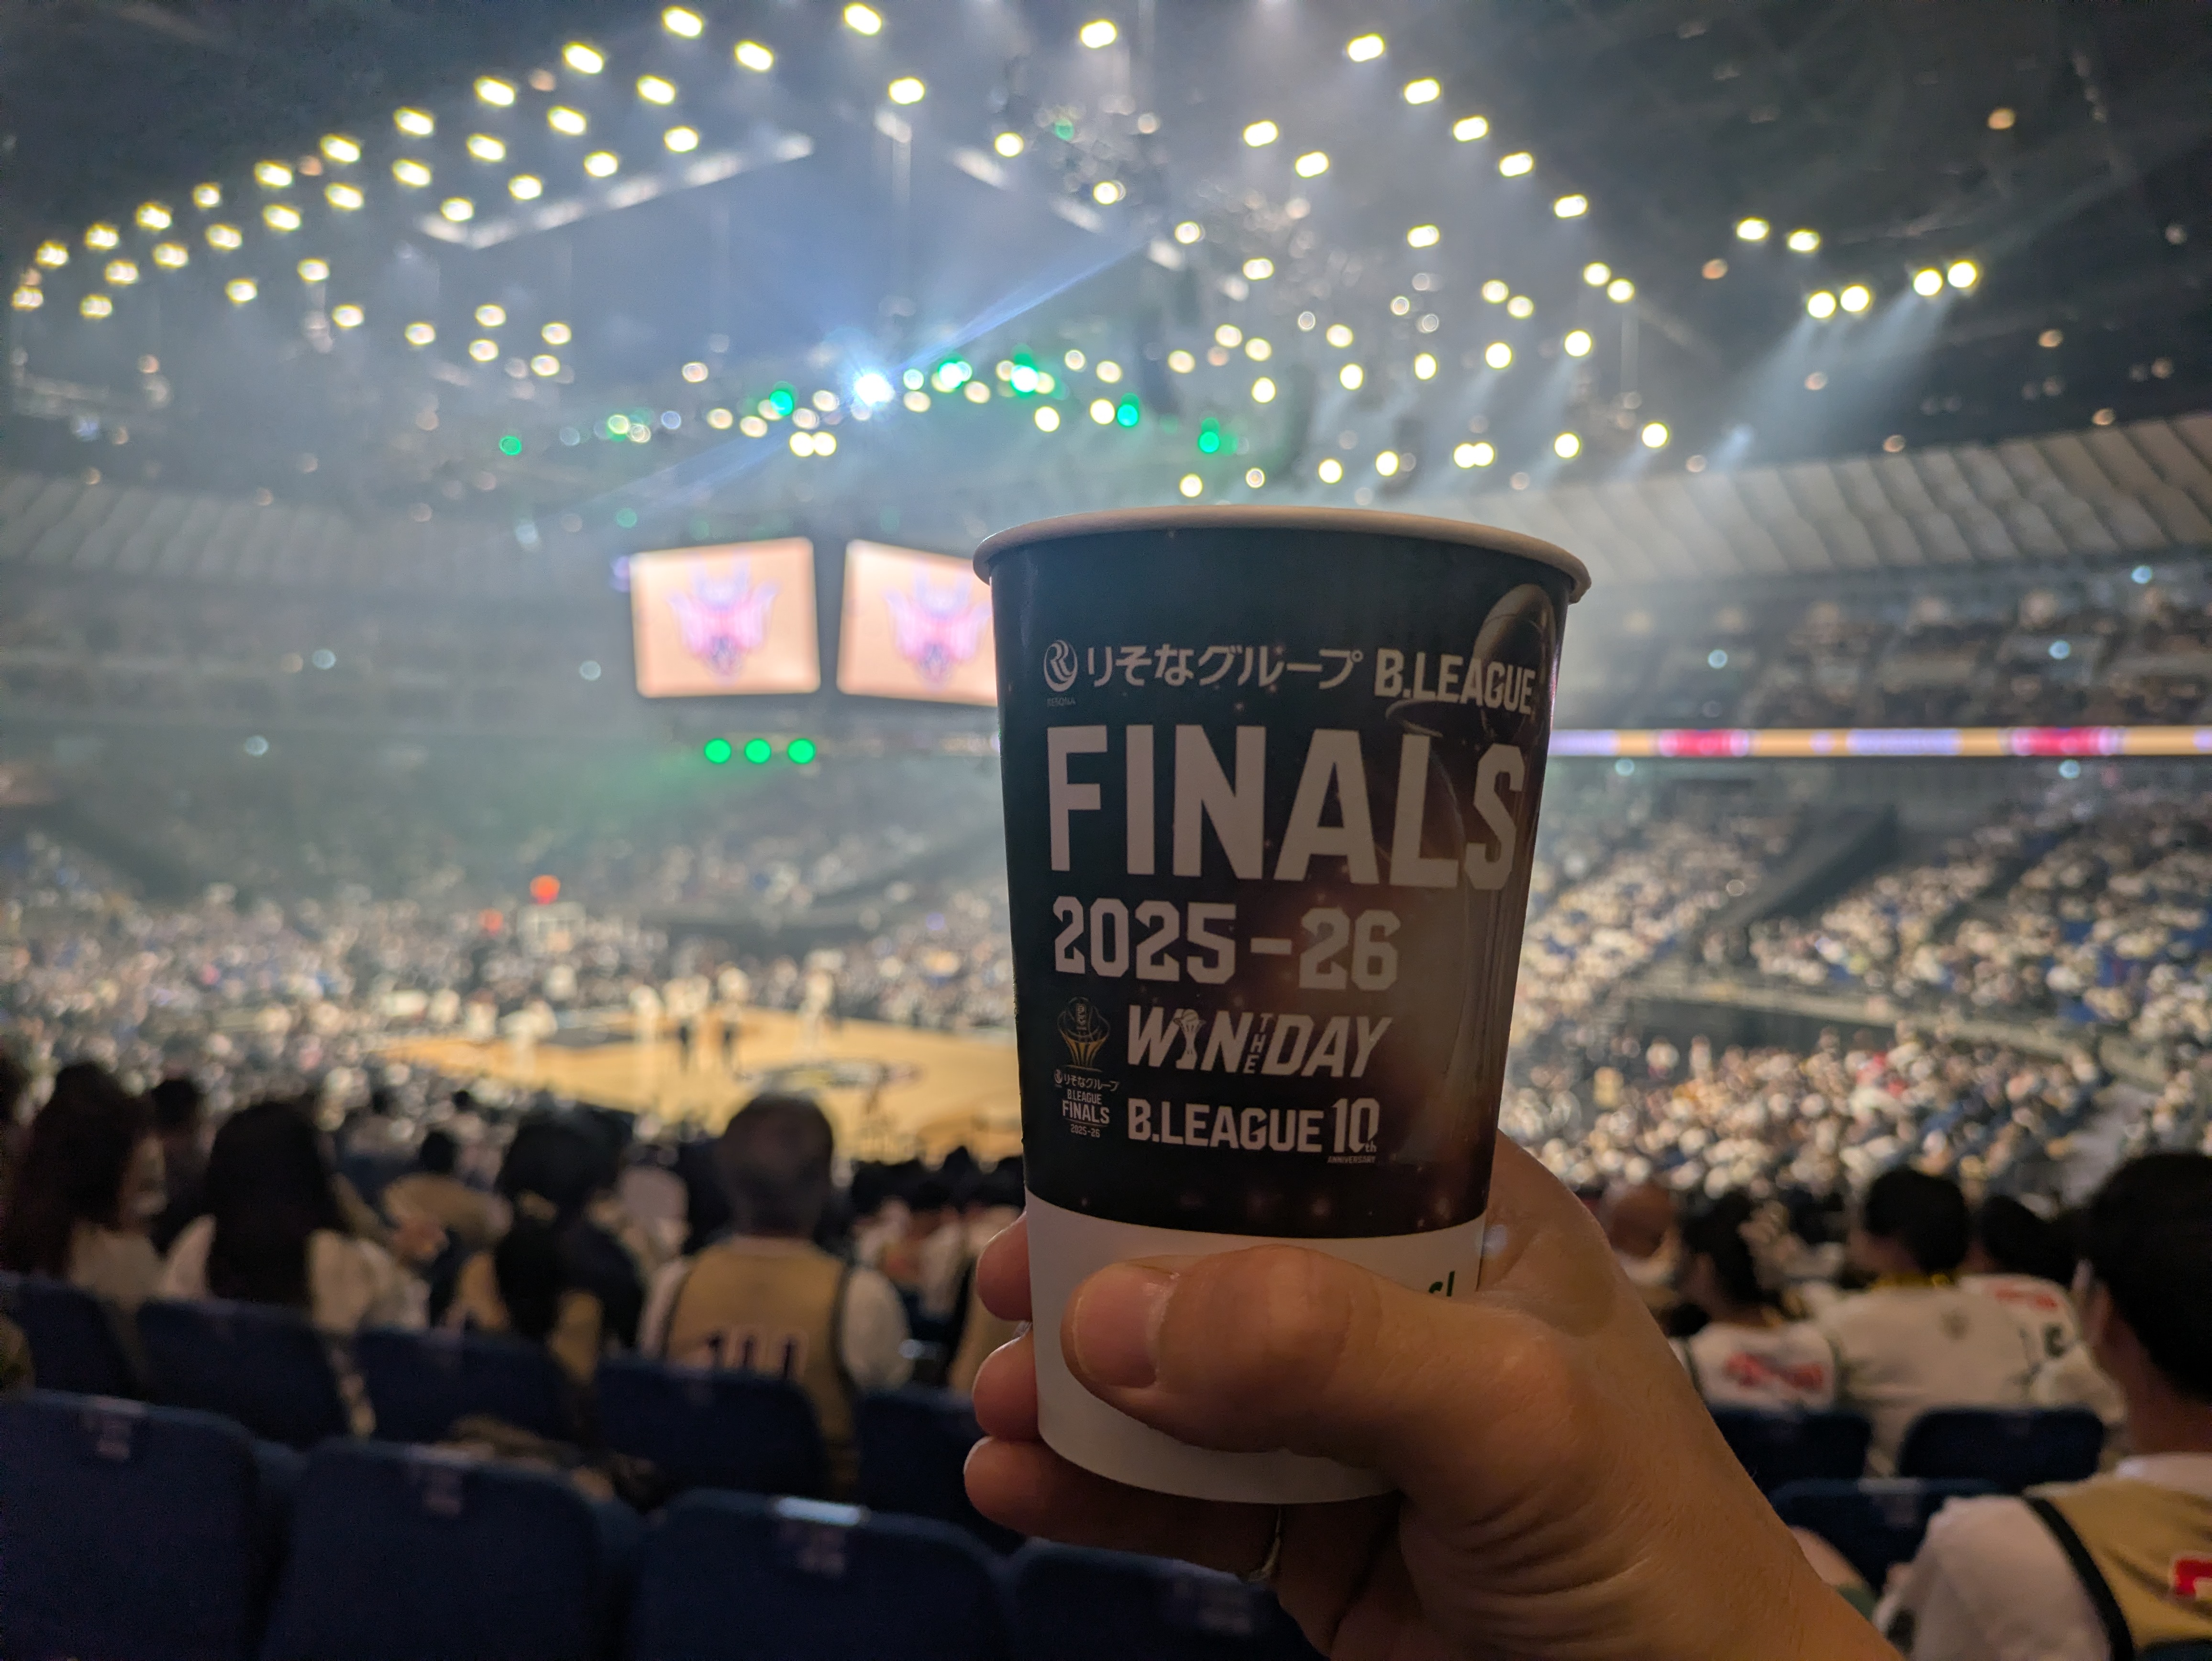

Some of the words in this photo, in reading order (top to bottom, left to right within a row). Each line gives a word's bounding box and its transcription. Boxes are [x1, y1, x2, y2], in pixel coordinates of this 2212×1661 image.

[1087, 643, 1363, 689] りそなグループ
[1374, 648, 1536, 716] B.LEAGUE
[1047, 724, 1526, 890] FINALS
[1053, 896, 1401, 991] 2025-26
[1261, 1013, 1393, 1078] DAY
[1062, 1099, 1110, 1124] FINALS
[1067, 1088, 1102, 1105] B.LEAGUE
[1128, 1097, 1324, 1153] B.LEAGUE
[1071, 1124, 1101, 1138] 2025-26
